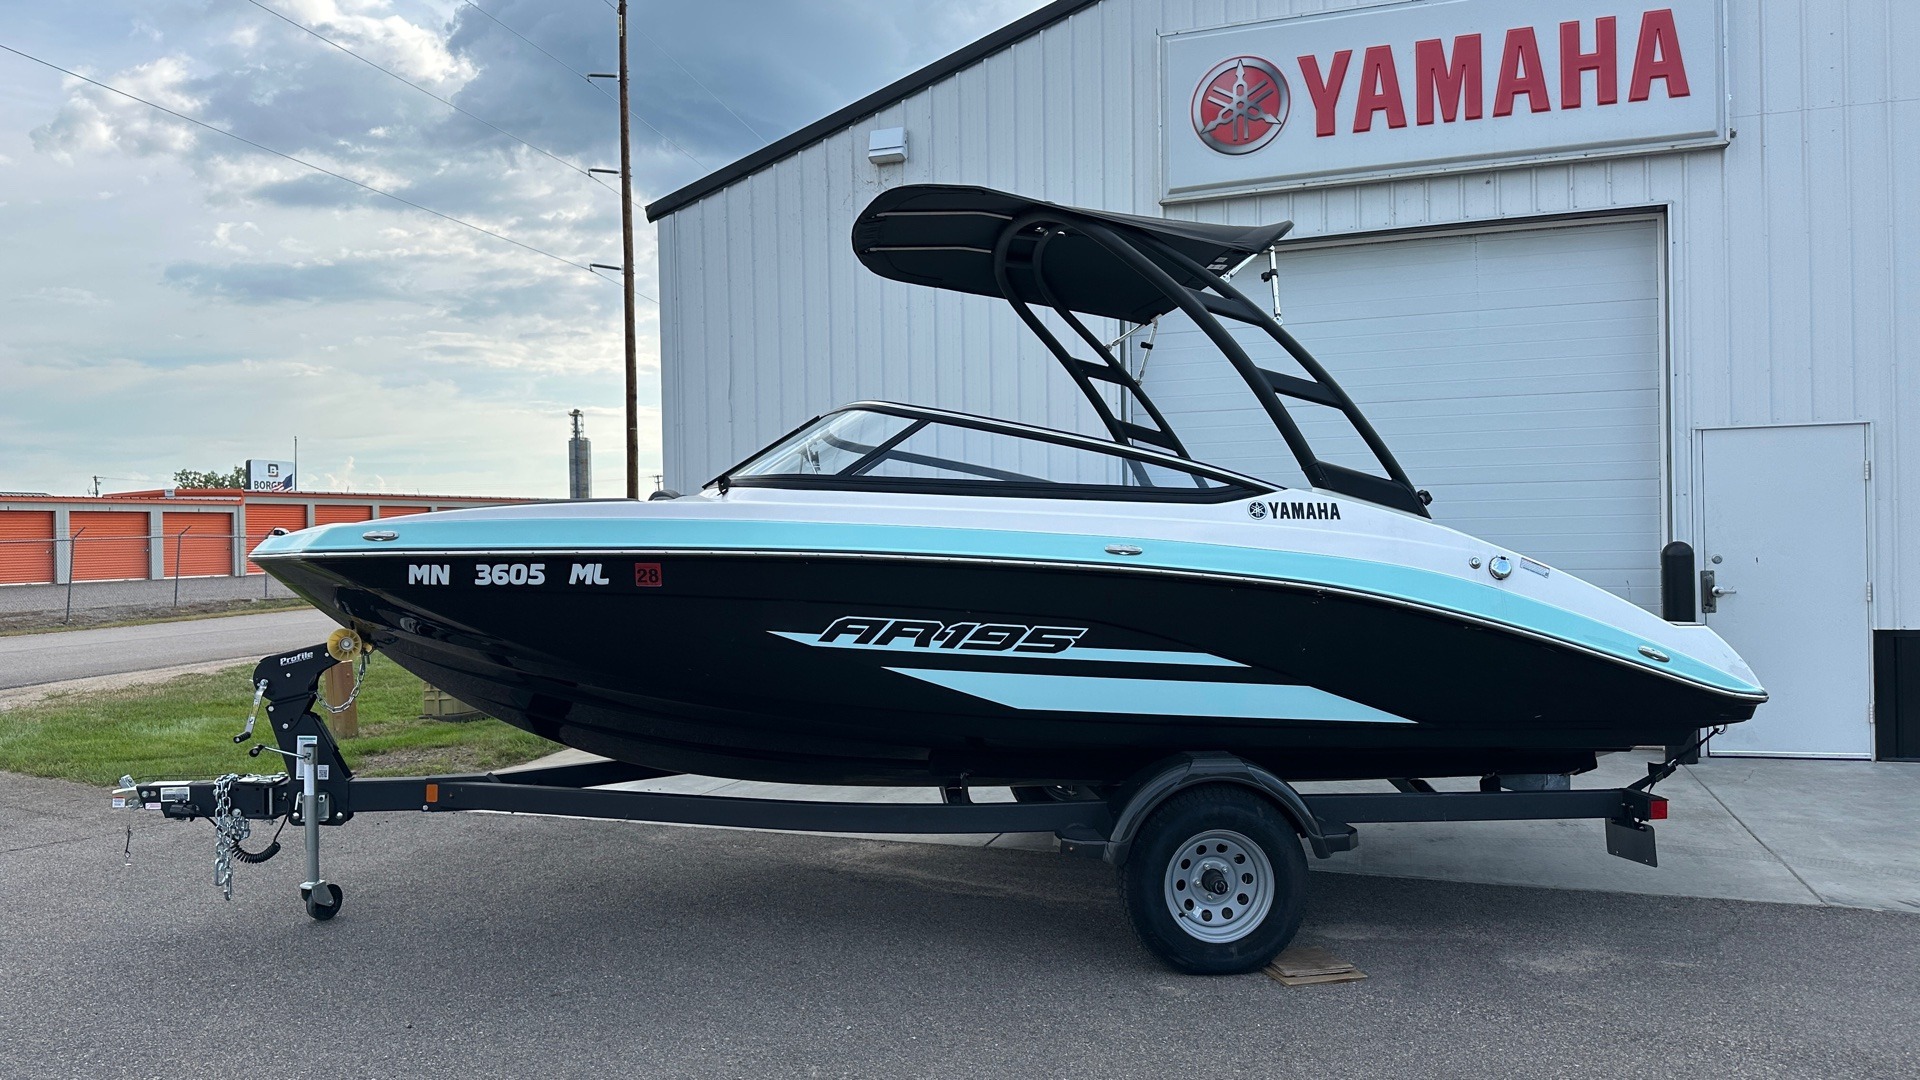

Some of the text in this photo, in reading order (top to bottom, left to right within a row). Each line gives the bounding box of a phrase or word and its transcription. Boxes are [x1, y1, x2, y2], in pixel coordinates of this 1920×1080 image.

[1297, 9, 1691, 137] YAMAHA
[1268, 502, 1341, 520] YAMAHA
[408, 563, 609, 586] MN 3605 ML
[637, 568, 659, 583] 28
[817, 615, 1089, 655] AR195
[280, 651, 314, 665] Profile
